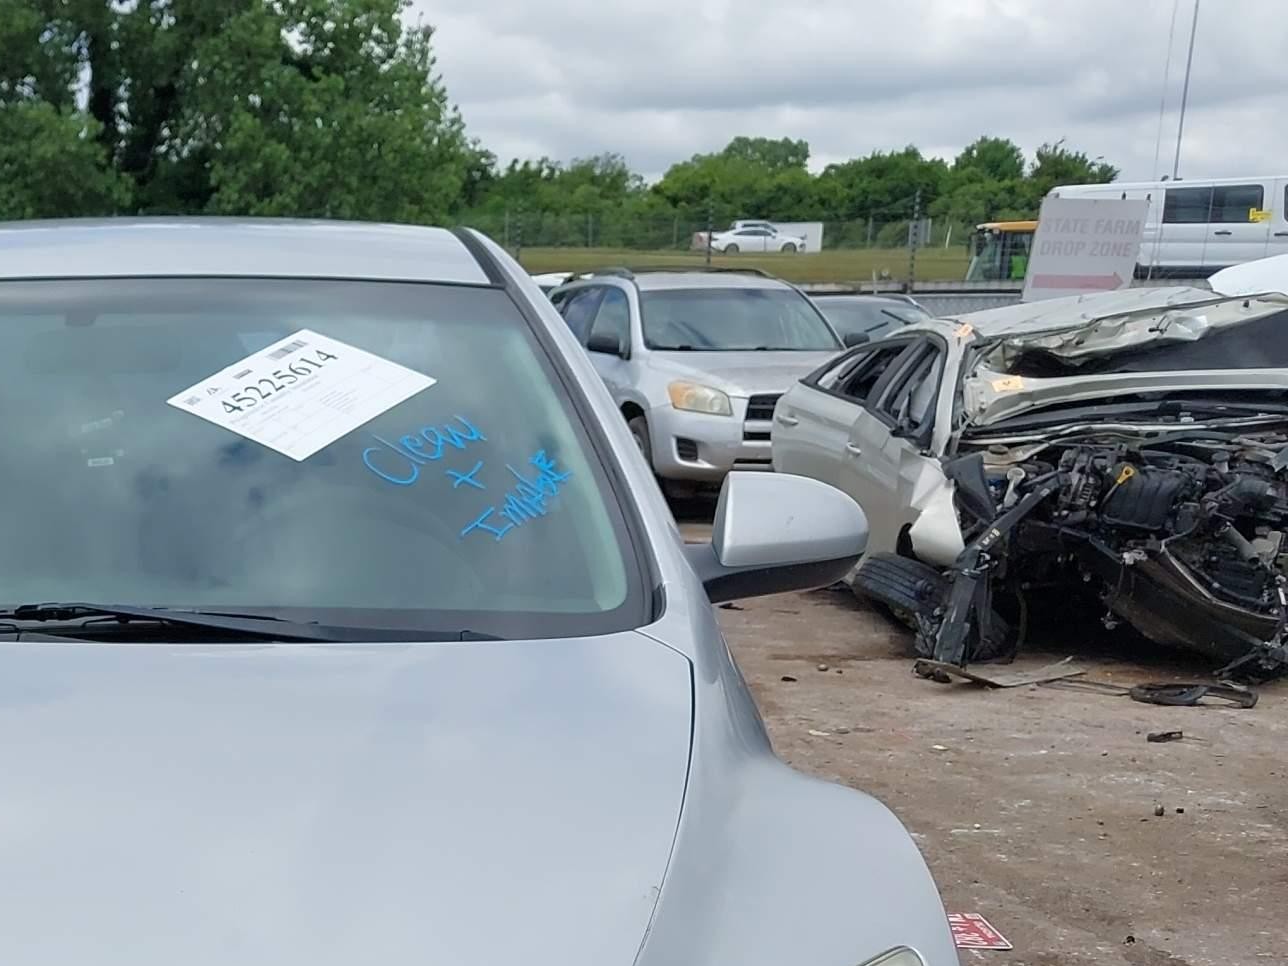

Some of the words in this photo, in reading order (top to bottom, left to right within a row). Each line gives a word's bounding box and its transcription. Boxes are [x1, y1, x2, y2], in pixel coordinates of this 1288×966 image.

[1042, 218, 1088, 235] STATE
[1095, 218, 1142, 236] FARM
[1040, 241, 1086, 256] DROP
[1090, 241, 1134, 258] ZONE
[220, 349, 339, 415] 45225614
